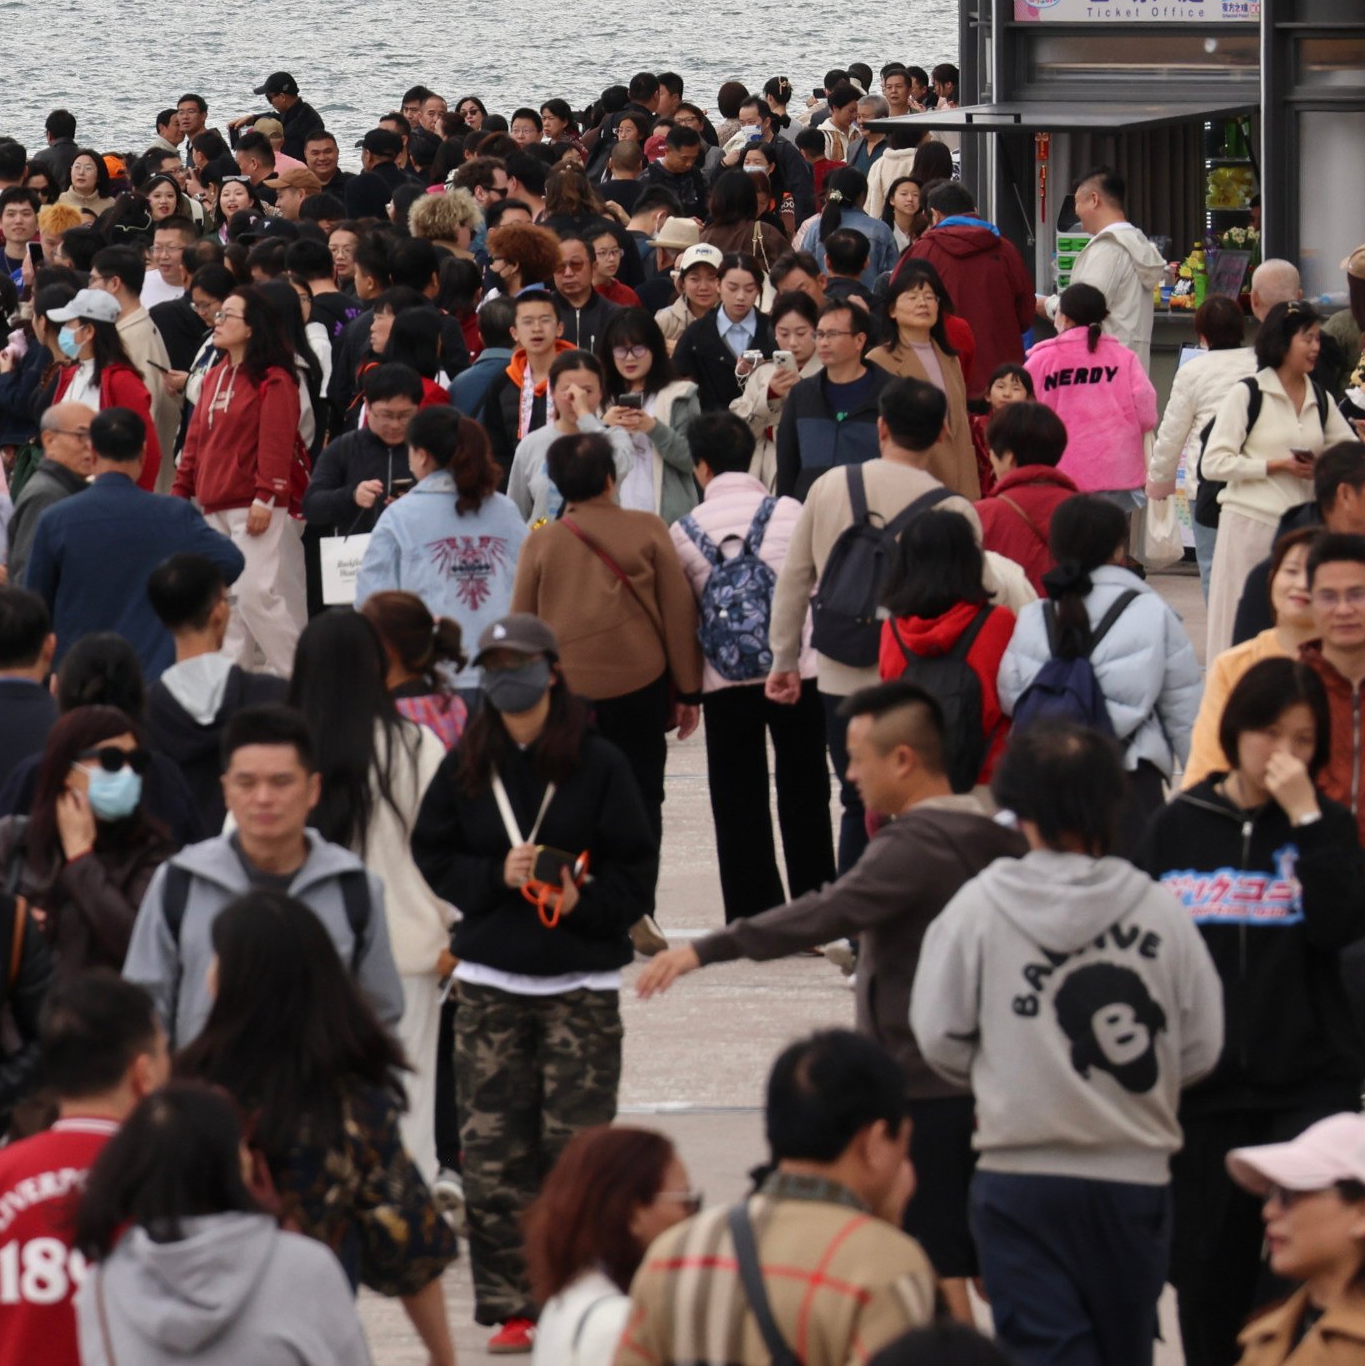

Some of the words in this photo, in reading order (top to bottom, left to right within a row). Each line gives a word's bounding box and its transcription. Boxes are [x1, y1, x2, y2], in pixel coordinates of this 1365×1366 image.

[1087, 7, 1140, 18] Ticket
[1151, 7, 1205, 18] Office
[1044, 365, 1119, 392] NERDY
